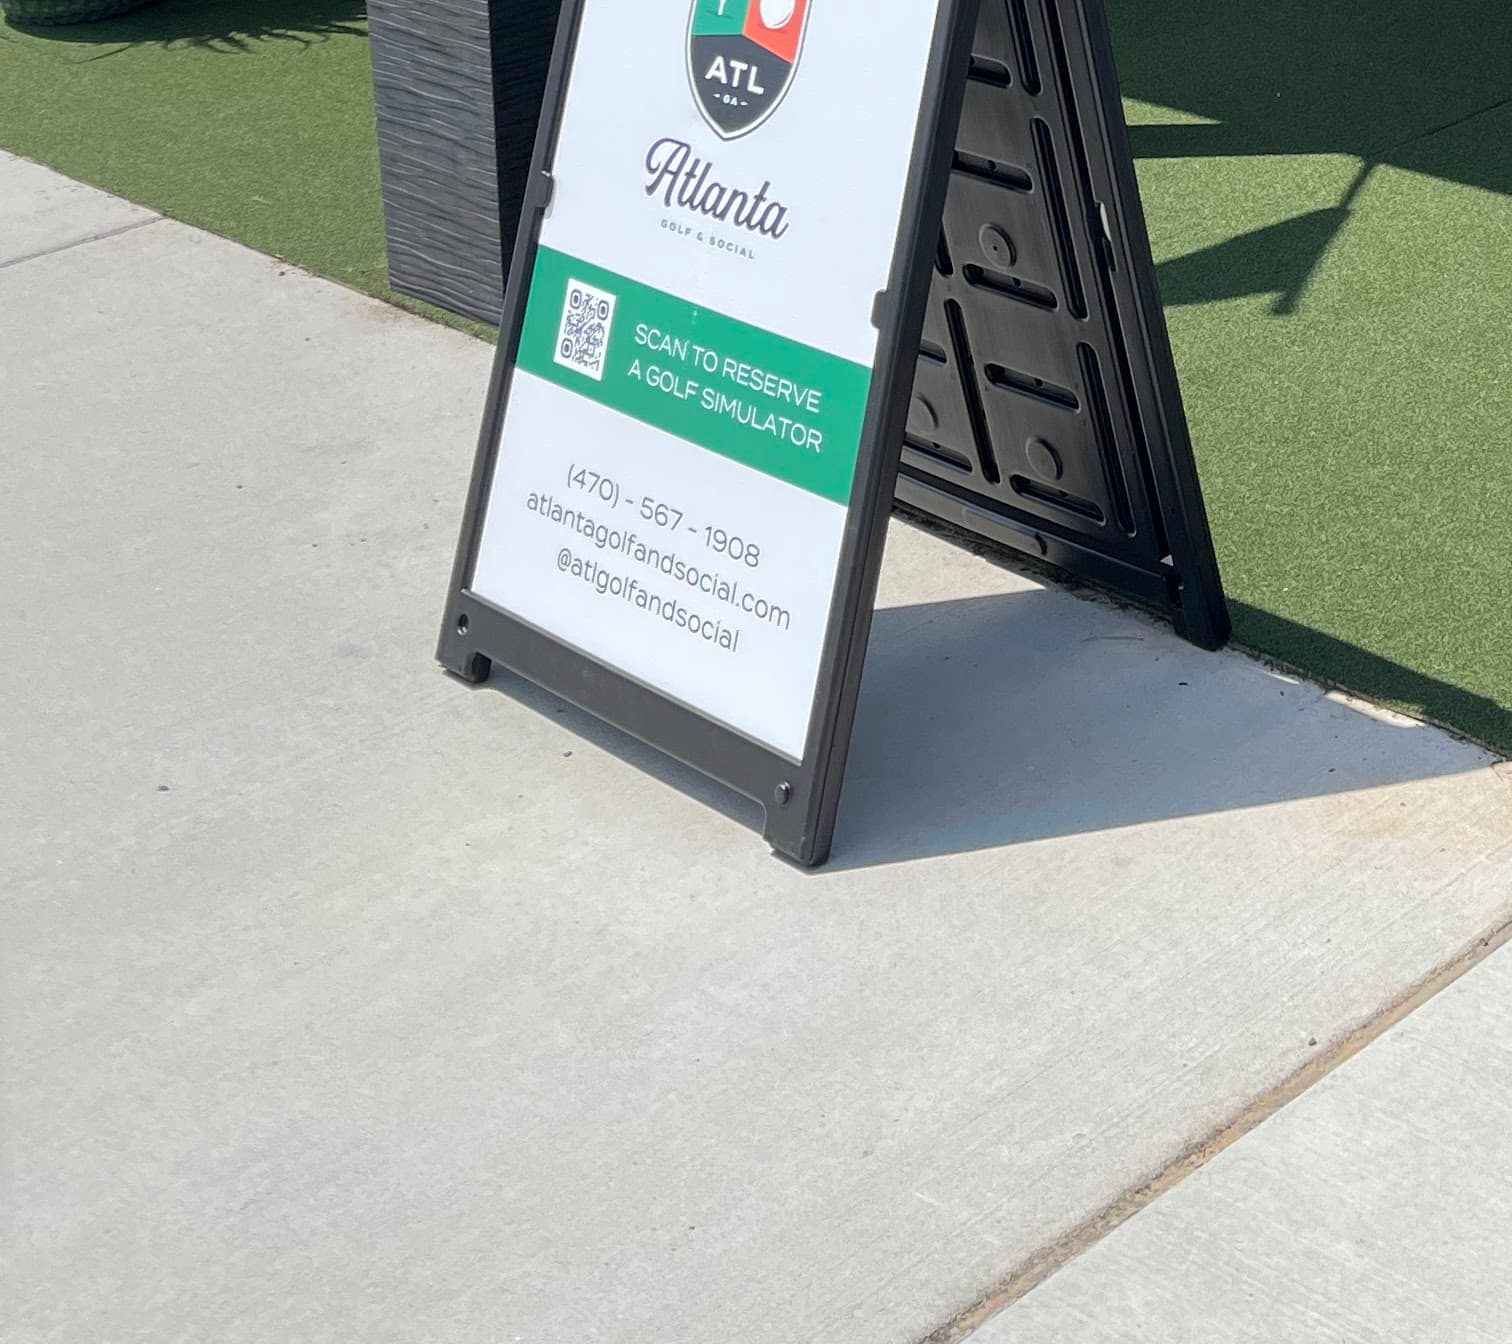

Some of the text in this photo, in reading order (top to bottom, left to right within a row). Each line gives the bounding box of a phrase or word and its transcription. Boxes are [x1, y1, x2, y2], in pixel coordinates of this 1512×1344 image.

[705, 56, 764, 95] ATL
[722, 94, 738, 106] GA
[645, 137, 789, 239] Atlanta
[660, 219, 755, 260] GOLF & SOCIAL
[627, 359, 823, 454] A GOLF SIMULATOR
[634, 323, 823, 413] SCAN TO RESERVE
[526, 492, 791, 631] atlantagolfandsocial.com
[567, 463, 620, 509] (470)
[640, 497, 684, 531] 567
[705, 525, 761, 568] 1908
[557, 548, 740, 653] @atlgolfandsocial
